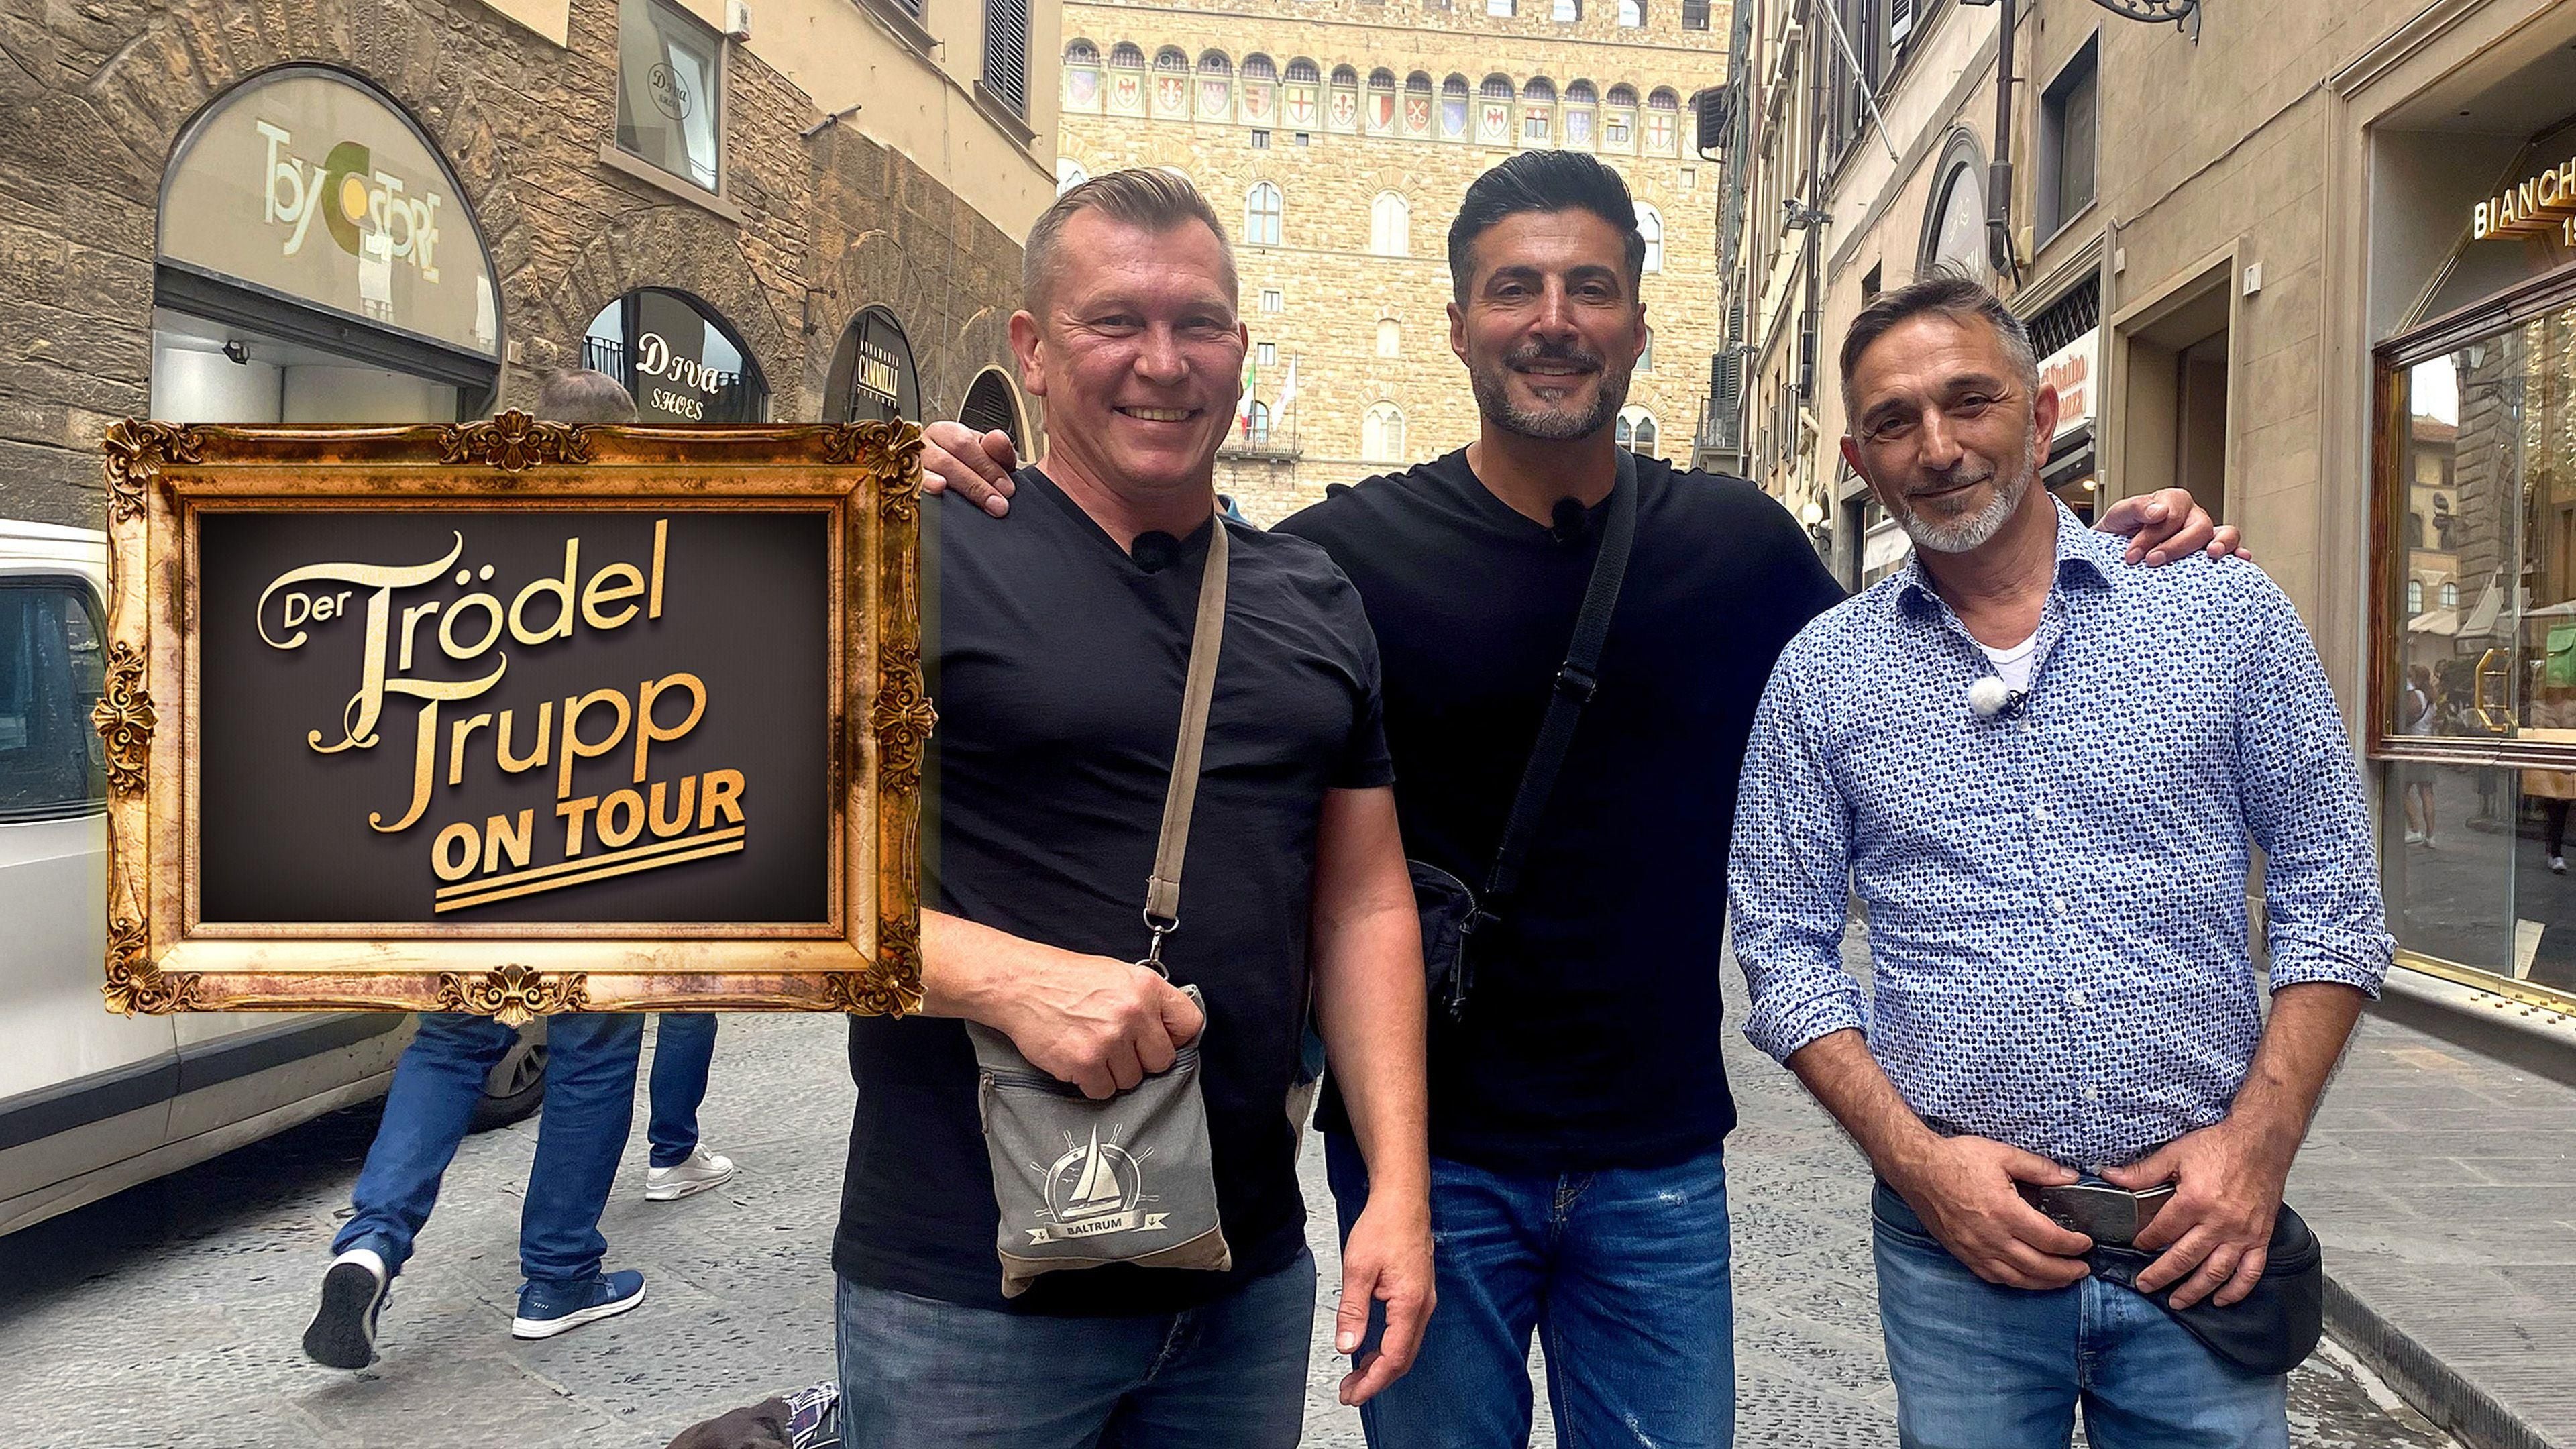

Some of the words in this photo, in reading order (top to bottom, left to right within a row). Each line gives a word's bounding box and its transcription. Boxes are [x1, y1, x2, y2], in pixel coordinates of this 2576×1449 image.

[2562, 215, 2576, 247] 1
[651, 388, 704, 421] SHOES
[1067, 1218, 1122, 1236] BALTRUM
